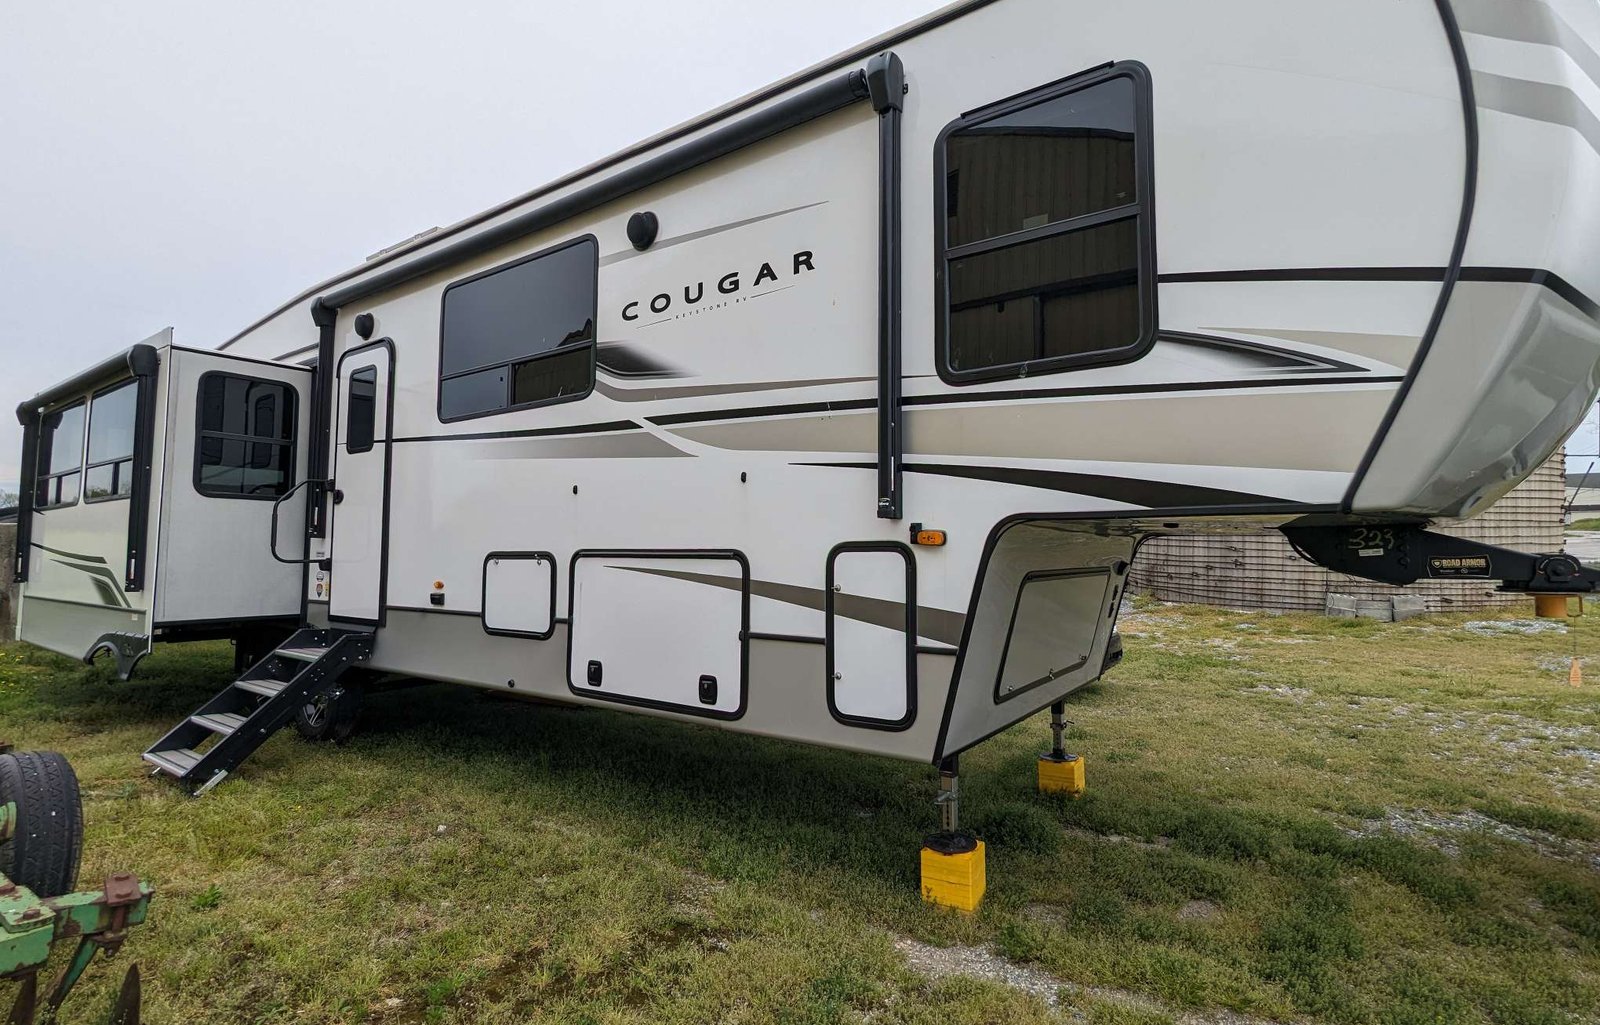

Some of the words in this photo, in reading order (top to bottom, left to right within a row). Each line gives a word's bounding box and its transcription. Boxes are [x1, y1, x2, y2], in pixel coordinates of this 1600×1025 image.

[621, 250, 815, 321] COUGAR
[675, 302, 728, 320] KEYSTONE
[736, 296, 747, 304] RV
[1348, 528, 1394, 550] 323
[1442, 559, 1461, 568] ROAD
[1461, 558, 1486, 568] ARMOR
